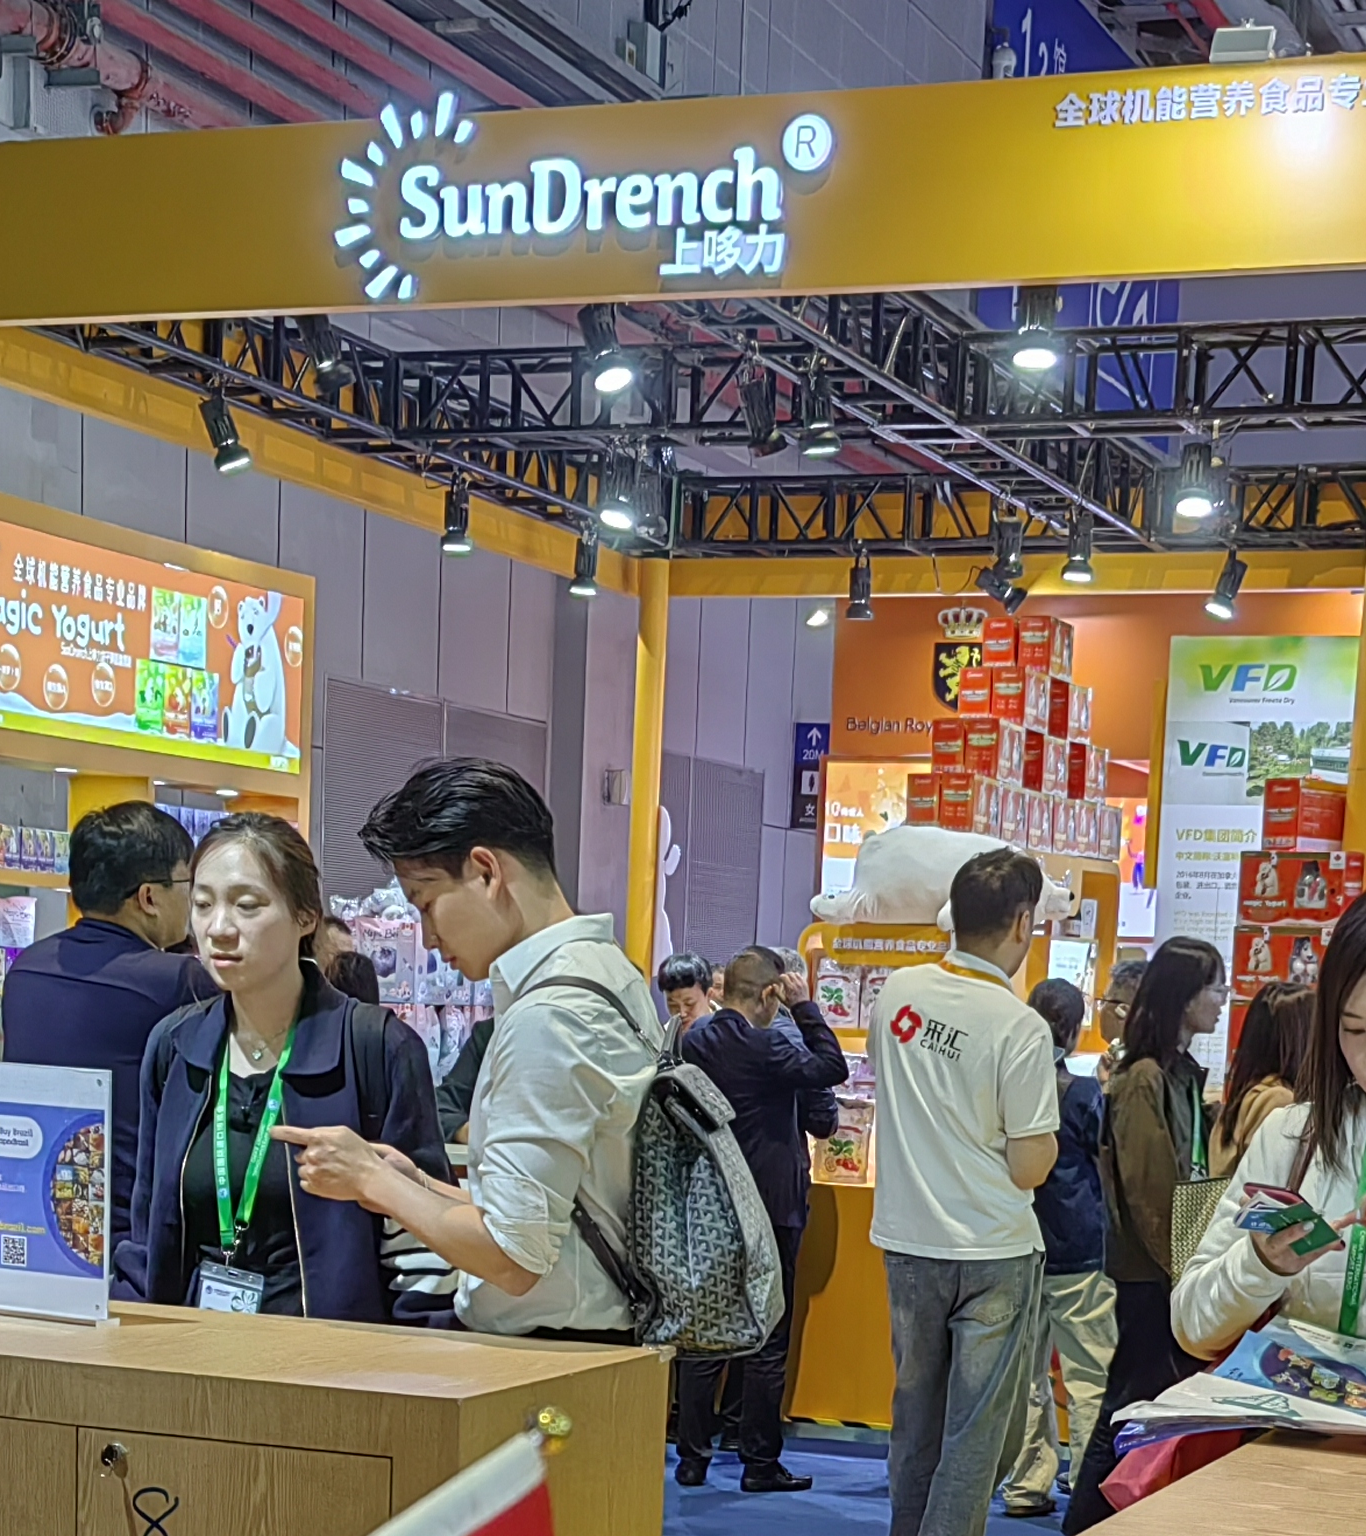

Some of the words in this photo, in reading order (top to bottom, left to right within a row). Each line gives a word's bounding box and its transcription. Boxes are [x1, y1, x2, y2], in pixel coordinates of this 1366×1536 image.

[400, 147, 782, 241] SunDrench
[660, 226, 786, 279] 上哆力
[13, 553, 146, 612] 全球机能营养食品专业品牌
[51, 604, 125, 651] Yogurt
[1199, 664, 1297, 692] VFD
[847, 717, 900, 734] Belgian
[1177, 740, 1246, 768] VFD
[920, 1039, 961, 1062] CAIHUI
